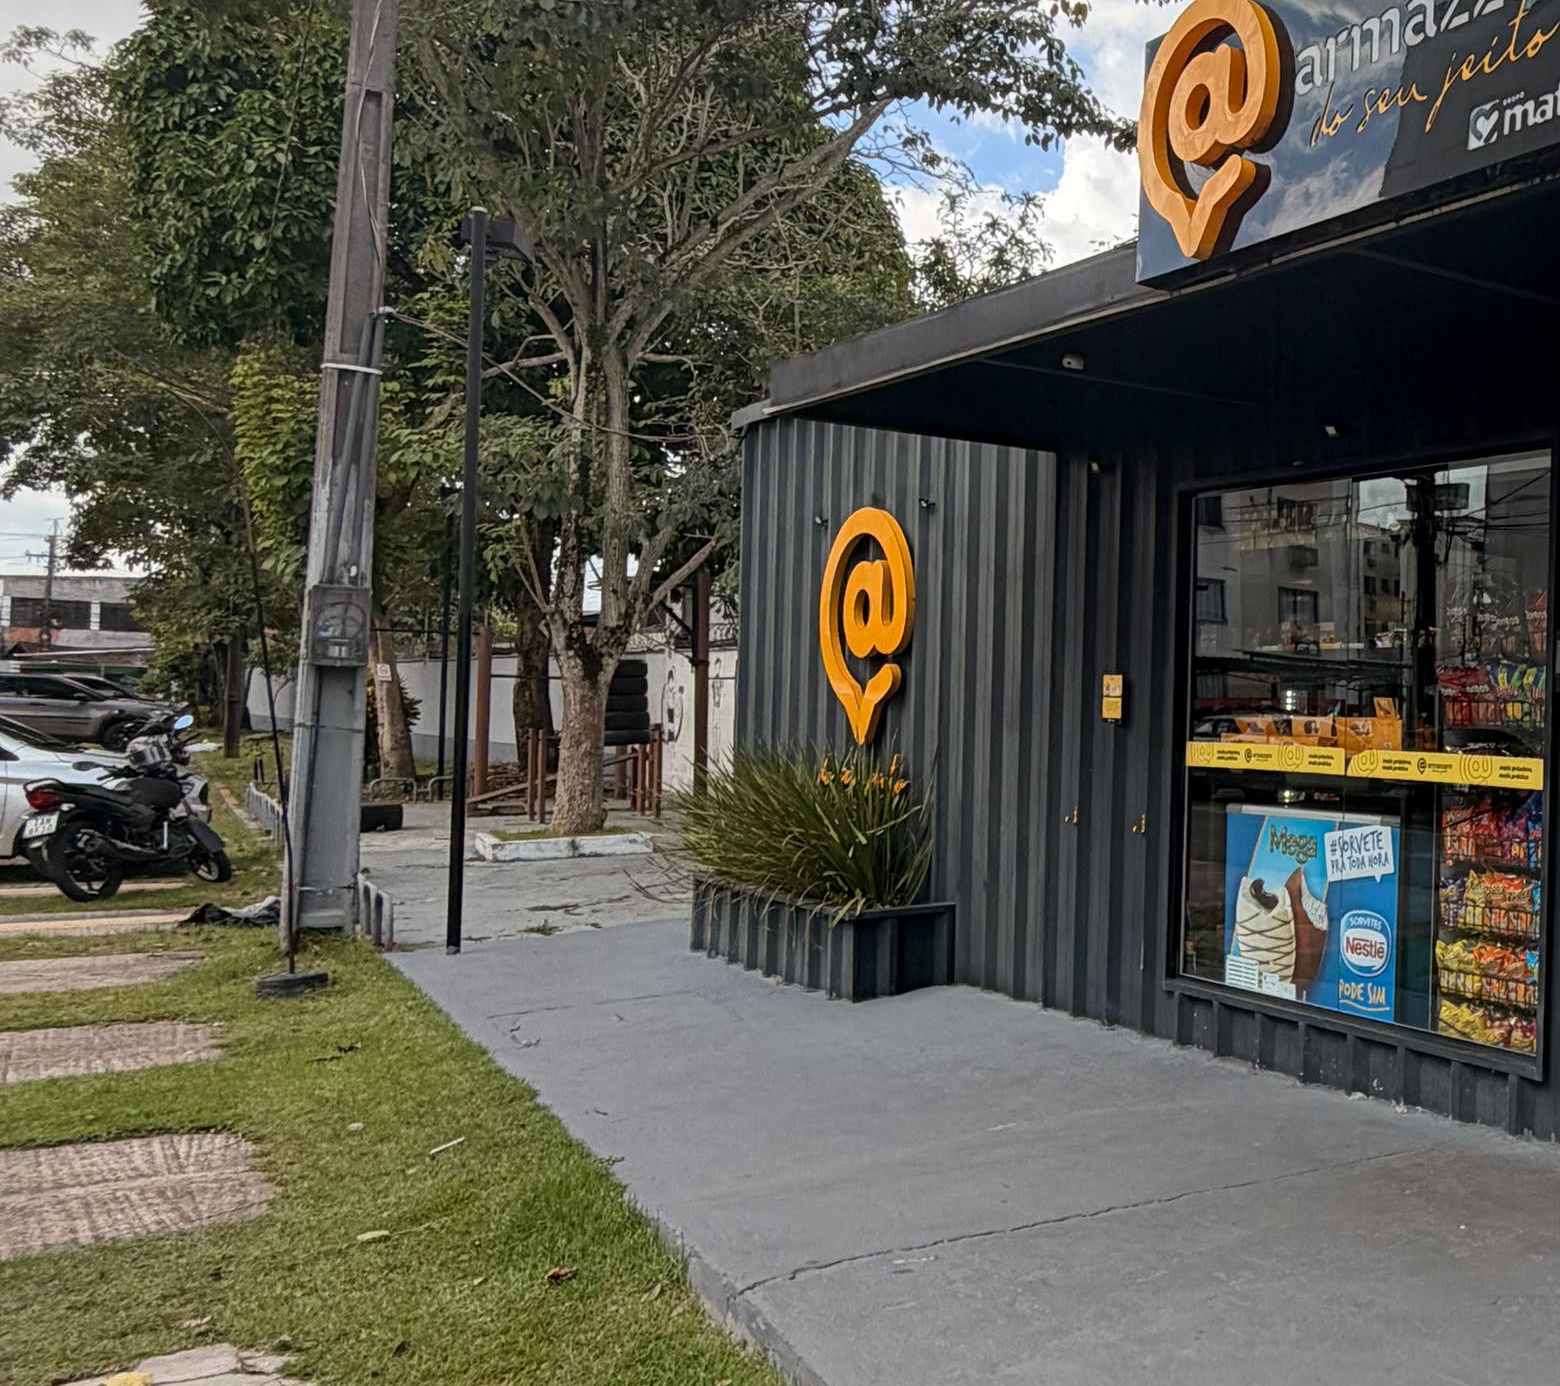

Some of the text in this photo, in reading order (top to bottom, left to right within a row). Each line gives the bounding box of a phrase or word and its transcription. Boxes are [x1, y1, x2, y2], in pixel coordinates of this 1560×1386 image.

[1309, 0, 1560, 149] do seu jeito
[1269, 824, 1318, 864] Mega
[1329, 829, 1385, 859] #SORVETE
[1330, 851, 1391, 875] PRA TODA HORA
[1349, 915, 1383, 931] SORVETES
[1338, 978, 1387, 1005] PODE SIM
